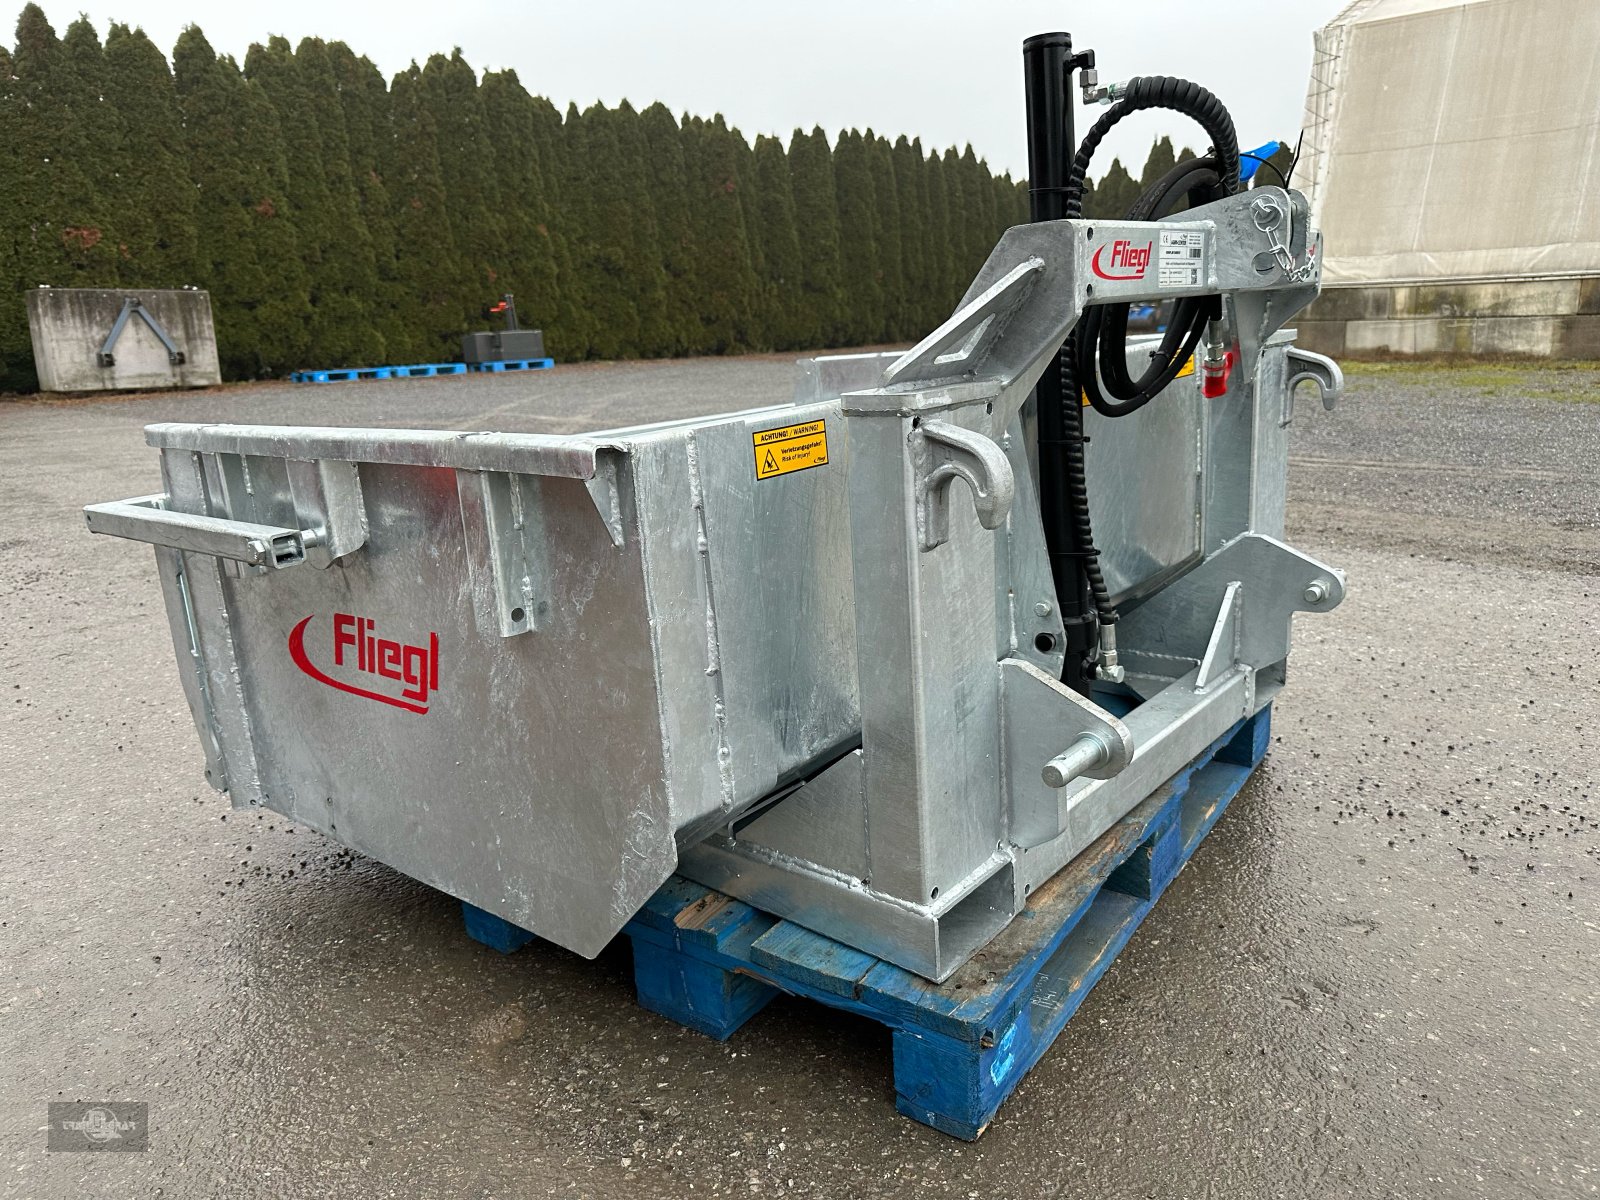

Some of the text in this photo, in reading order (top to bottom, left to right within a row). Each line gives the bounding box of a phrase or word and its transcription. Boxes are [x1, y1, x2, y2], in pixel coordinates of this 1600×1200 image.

[1111, 240, 1152, 273] Fliegl
[761, 430, 788, 442] ACHTUNG!
[793, 424, 819, 435] WARNING!
[334, 613, 439, 703] Fliegl
